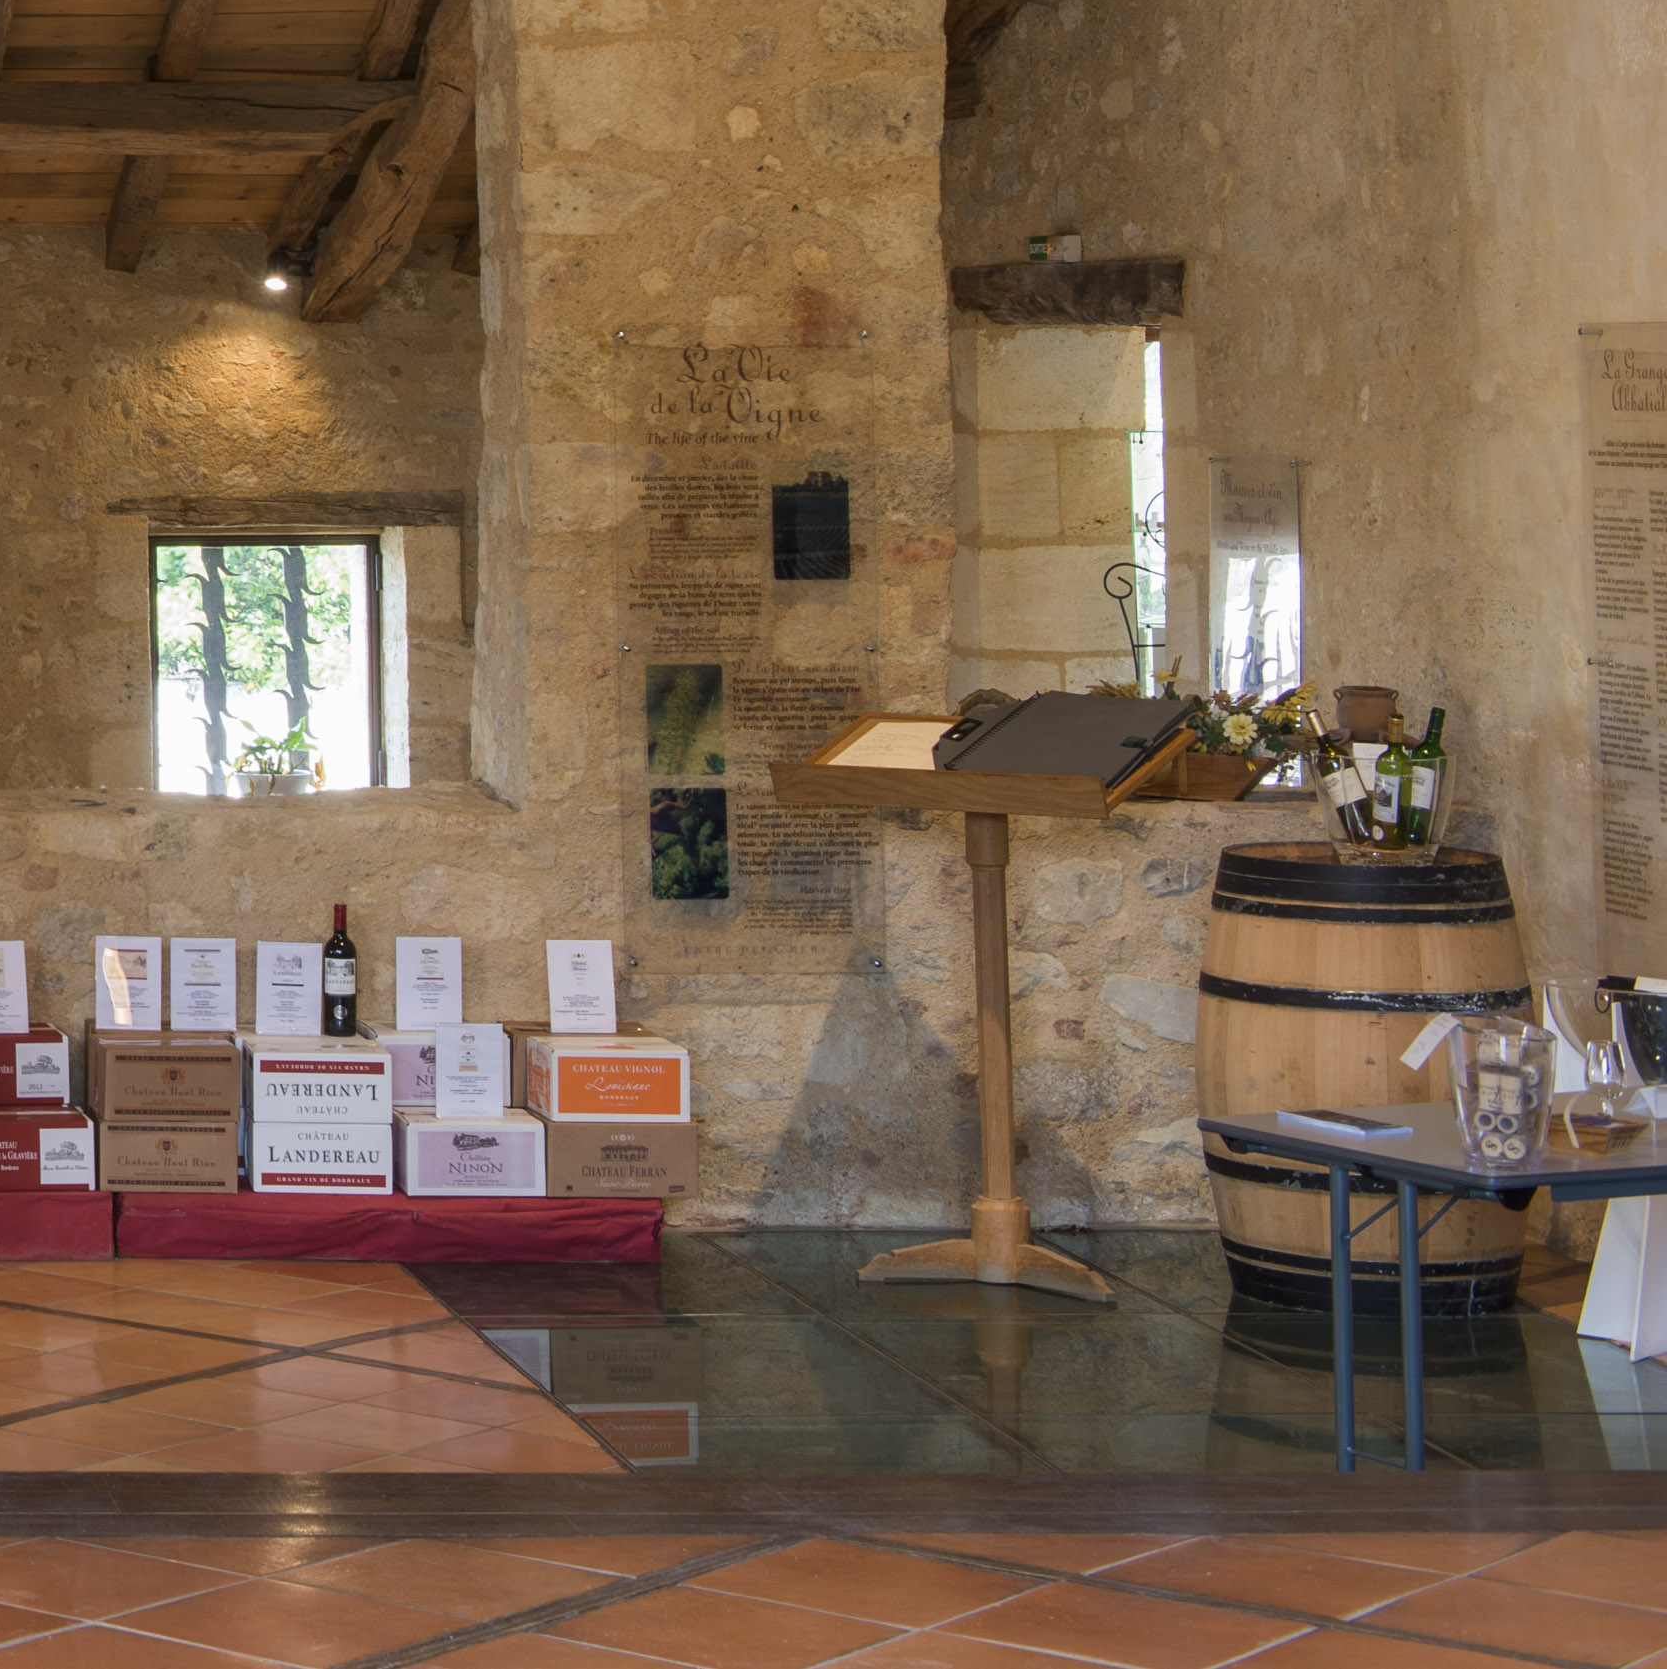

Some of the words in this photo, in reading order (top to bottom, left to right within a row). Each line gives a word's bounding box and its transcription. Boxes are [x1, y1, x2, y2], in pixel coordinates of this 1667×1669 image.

[677, 343, 726, 383] La
[725, 343, 797, 382] Vie
[1602, 348, 1620, 379] La
[651, 392, 679, 414] de
[690, 386, 713, 414] la
[714, 385, 825, 440] Vigne
[646, 433, 669, 444] The
[672, 432, 692, 446] life
[695, 432, 707, 447] of
[710, 433, 729, 444] the
[733, 433, 758, 444] vine
[572, 1064, 622, 1073] CHATEAU
[624, 1065, 665, 1074] VIGNOL
[585, 1076, 651, 1092] Louisiane
[265, 1083, 378, 1101] LANDEREAU
[297, 1106, 348, 1116] CHÂTEAU
[297, 1131, 350, 1141] CHÂTEAU
[7, 1151, 38, 1160] GRAVIÈRE
[268, 1146, 380, 1163] LANDEREAU
[449, 1162, 503, 1174] NINON
[581, 1165, 627, 1177] CHATEAU
[629, 1165, 668, 1177] FERRAN
